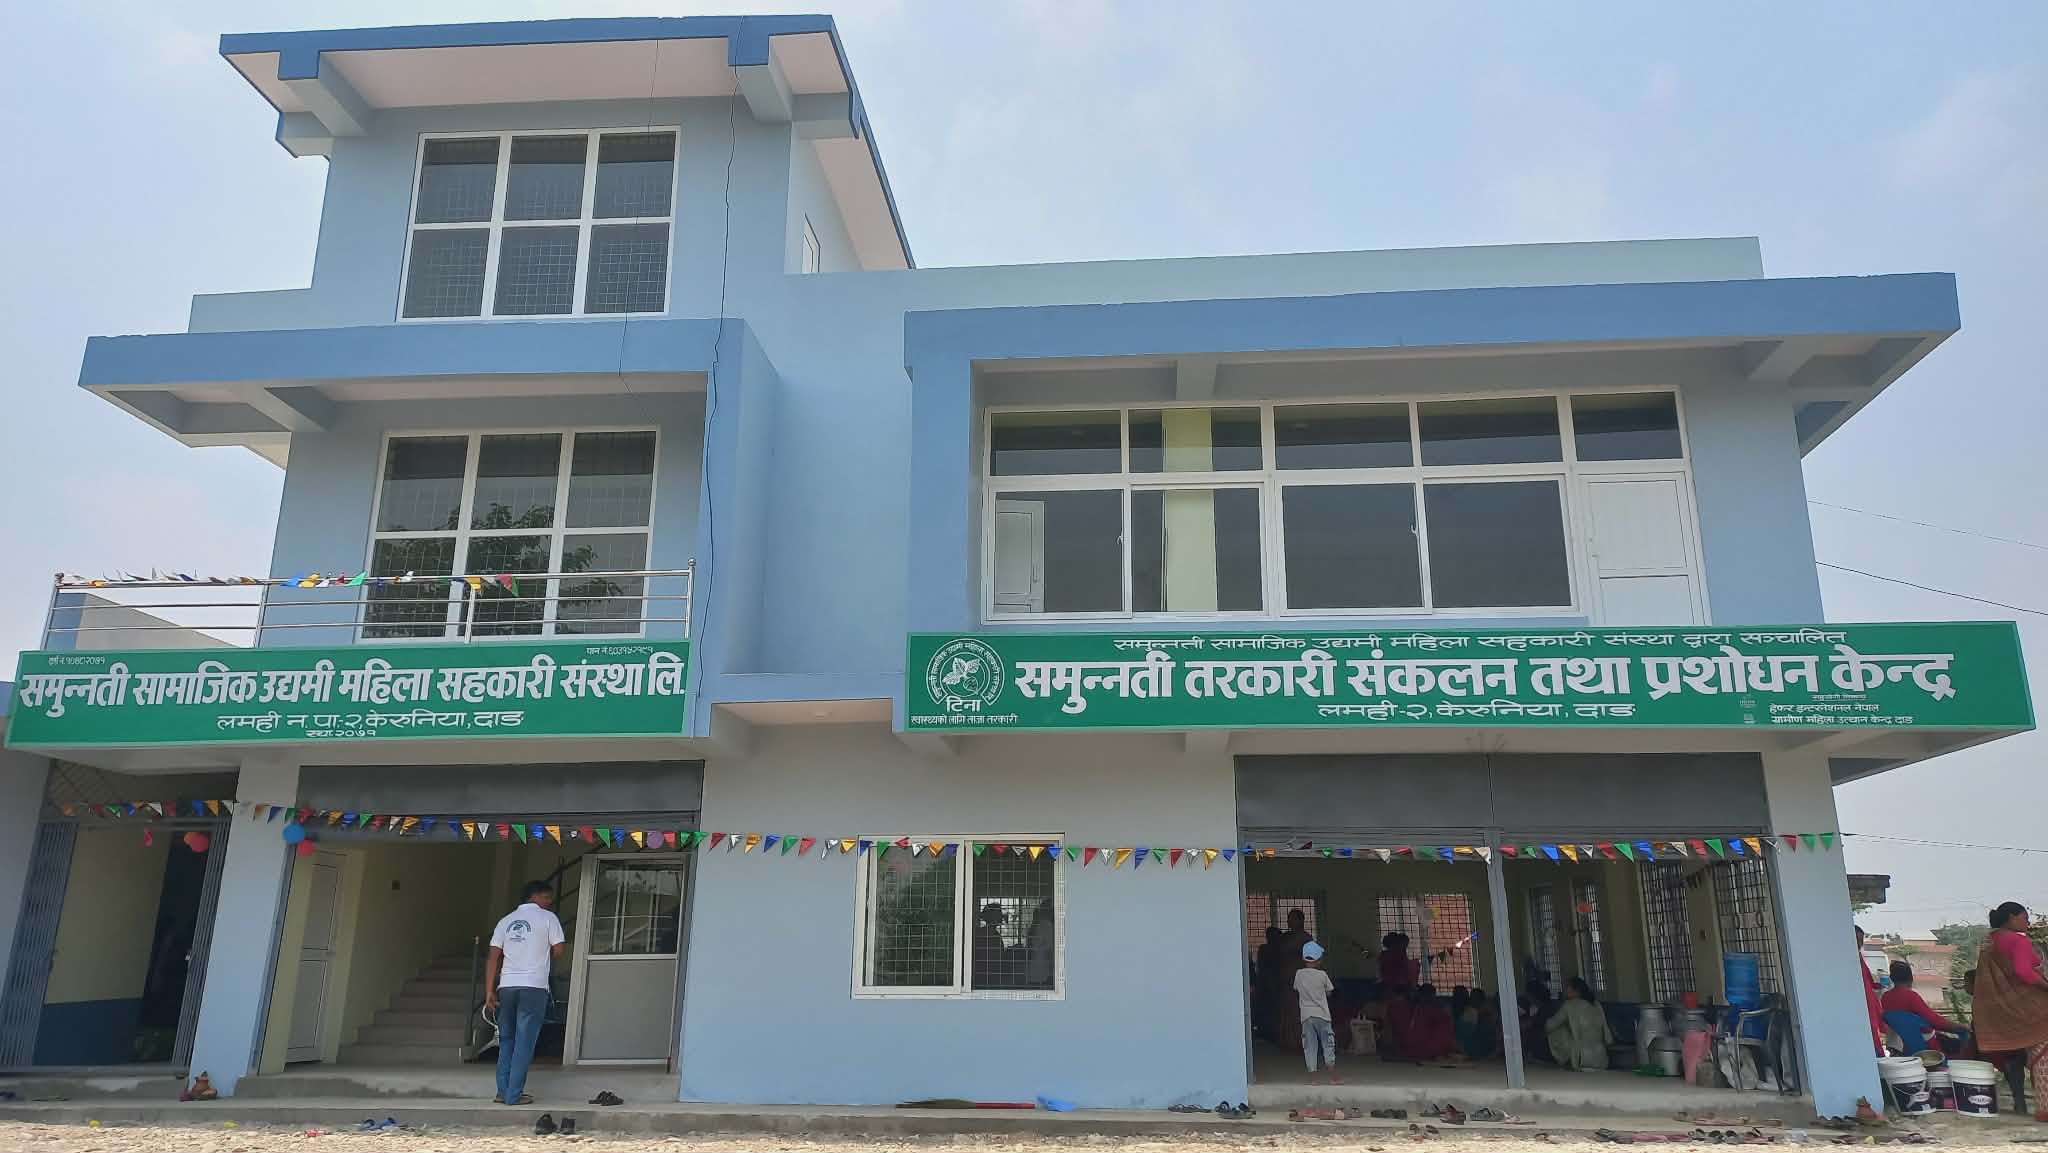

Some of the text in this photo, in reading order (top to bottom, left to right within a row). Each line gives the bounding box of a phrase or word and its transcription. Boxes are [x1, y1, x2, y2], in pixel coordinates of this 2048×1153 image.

[1211, 634, 1306, 649] सामाजिक
[1312, 633, 1380, 648] उद्यमी
[1391, 633, 1470, 651] महिला
[1478, 631, 1594, 650] सहकारी
[1604, 631, 1673, 646] संस्था
[1682, 631, 1731, 648] द्वारा
[20, 652, 686, 717] समुन्नती सामाजिक उद्यमी महिला सहकारी संस्था लि.
[1015, 650, 1175, 714] समुन्नती
[1185, 649, 1337, 698] तरकारी
[1347, 648, 1518, 697] संकलन
[1529, 654, 1631, 695] तथा
[1641, 645, 1818, 701] प्रशोधन
[1829, 643, 1956, 702] केन्द्र
[945, 696, 982, 711] टिना
[216, 711, 281, 733] लमही
[986, 713, 1018, 724] तरकारी
[1806, 714, 1835, 724] महिला
